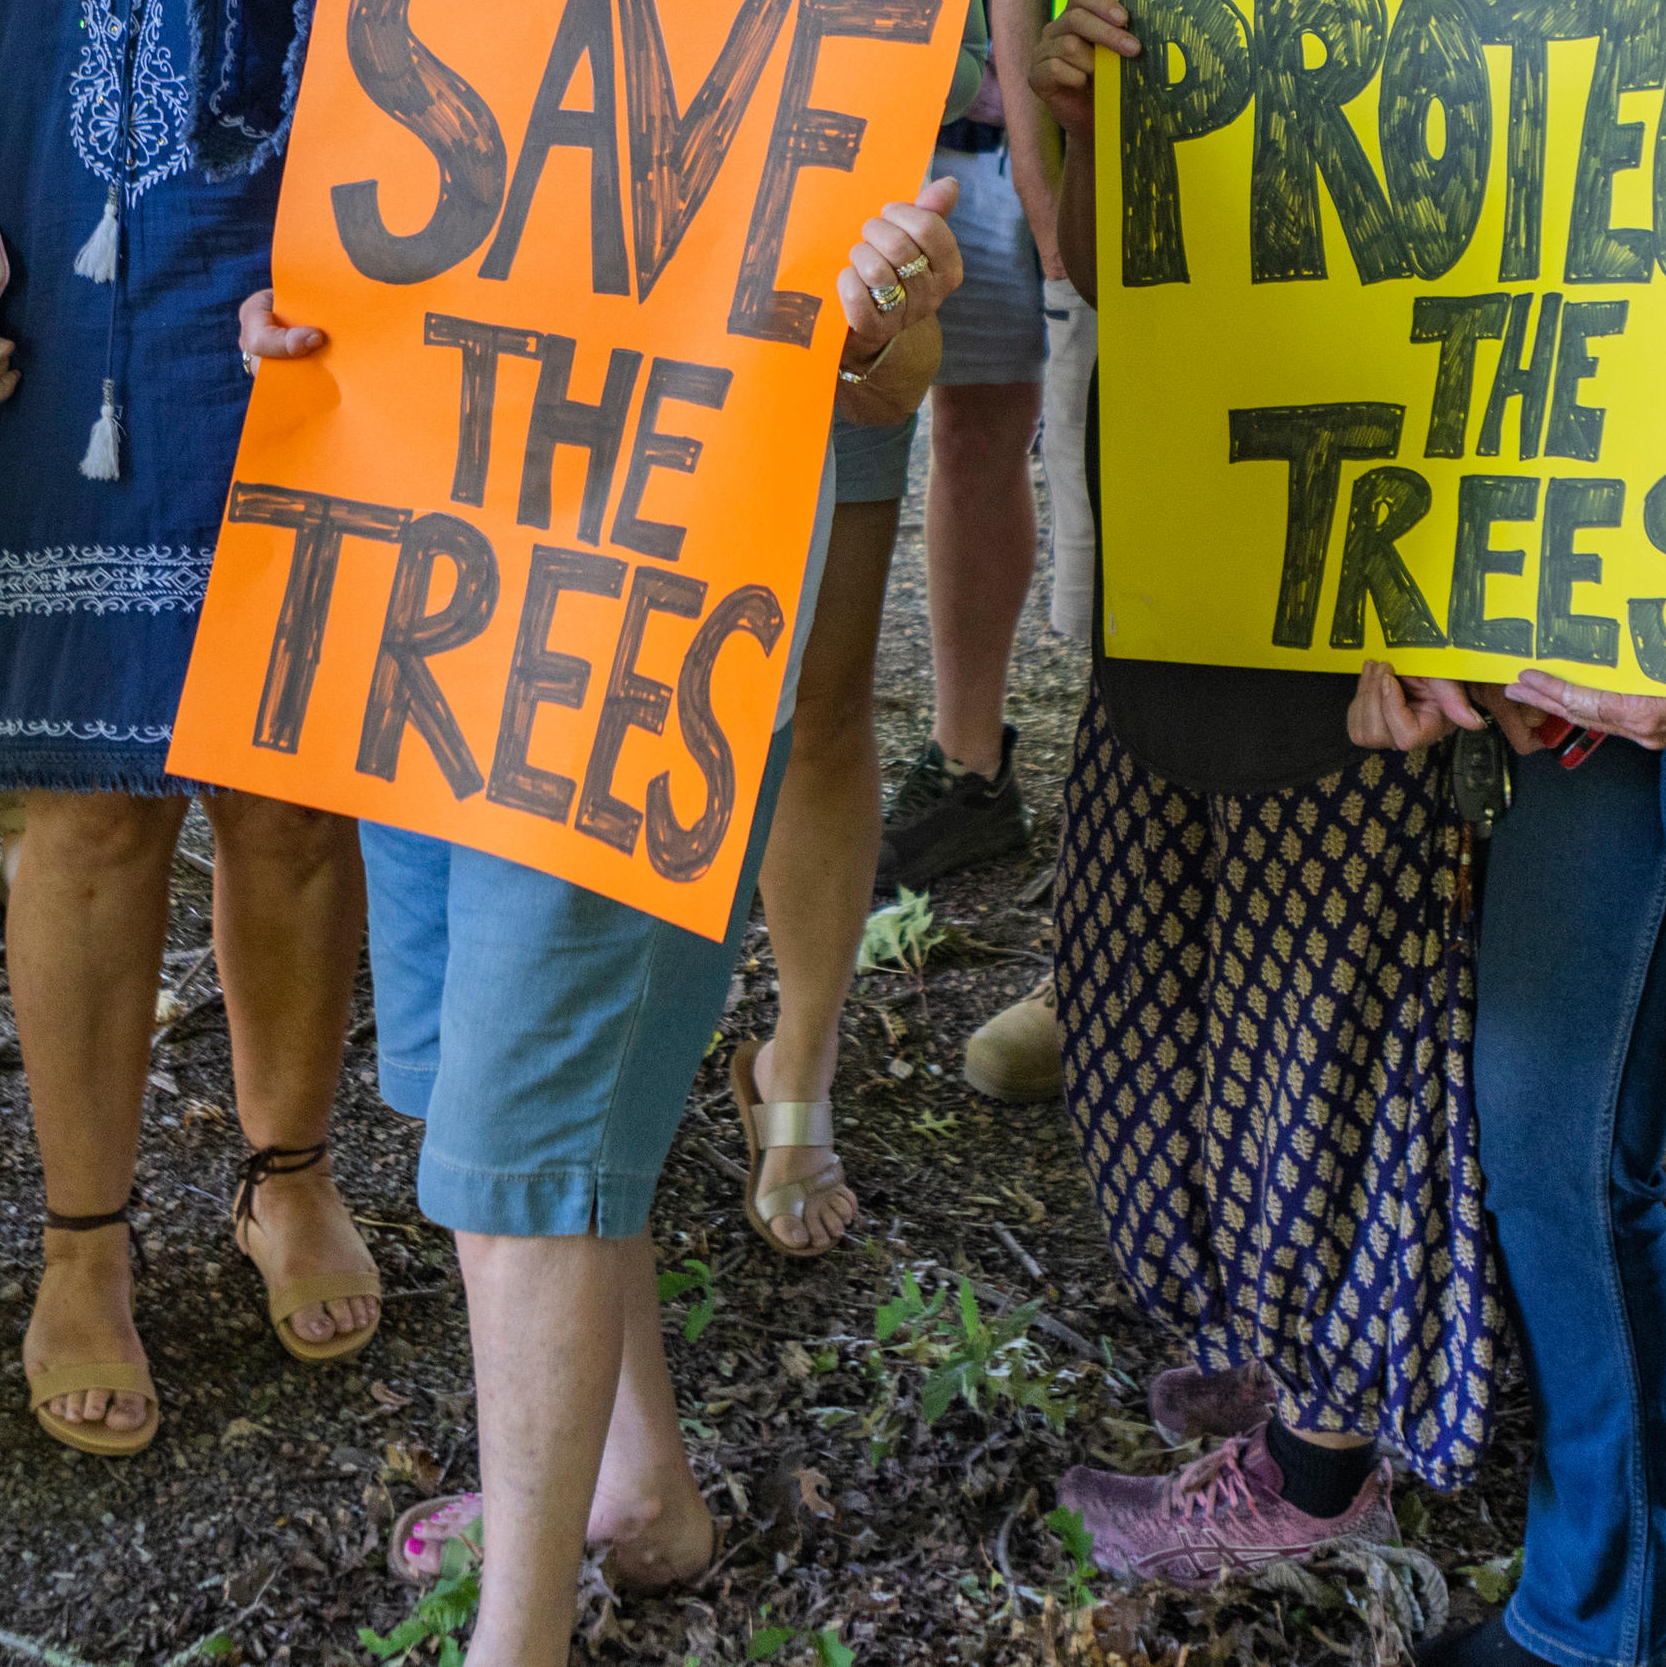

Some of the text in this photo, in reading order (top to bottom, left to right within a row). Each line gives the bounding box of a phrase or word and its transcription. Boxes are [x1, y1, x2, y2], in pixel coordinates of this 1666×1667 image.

[425, 312, 733, 562] THE
[1410, 292, 1629, 463] THE
[228, 480, 785, 883] TREES
